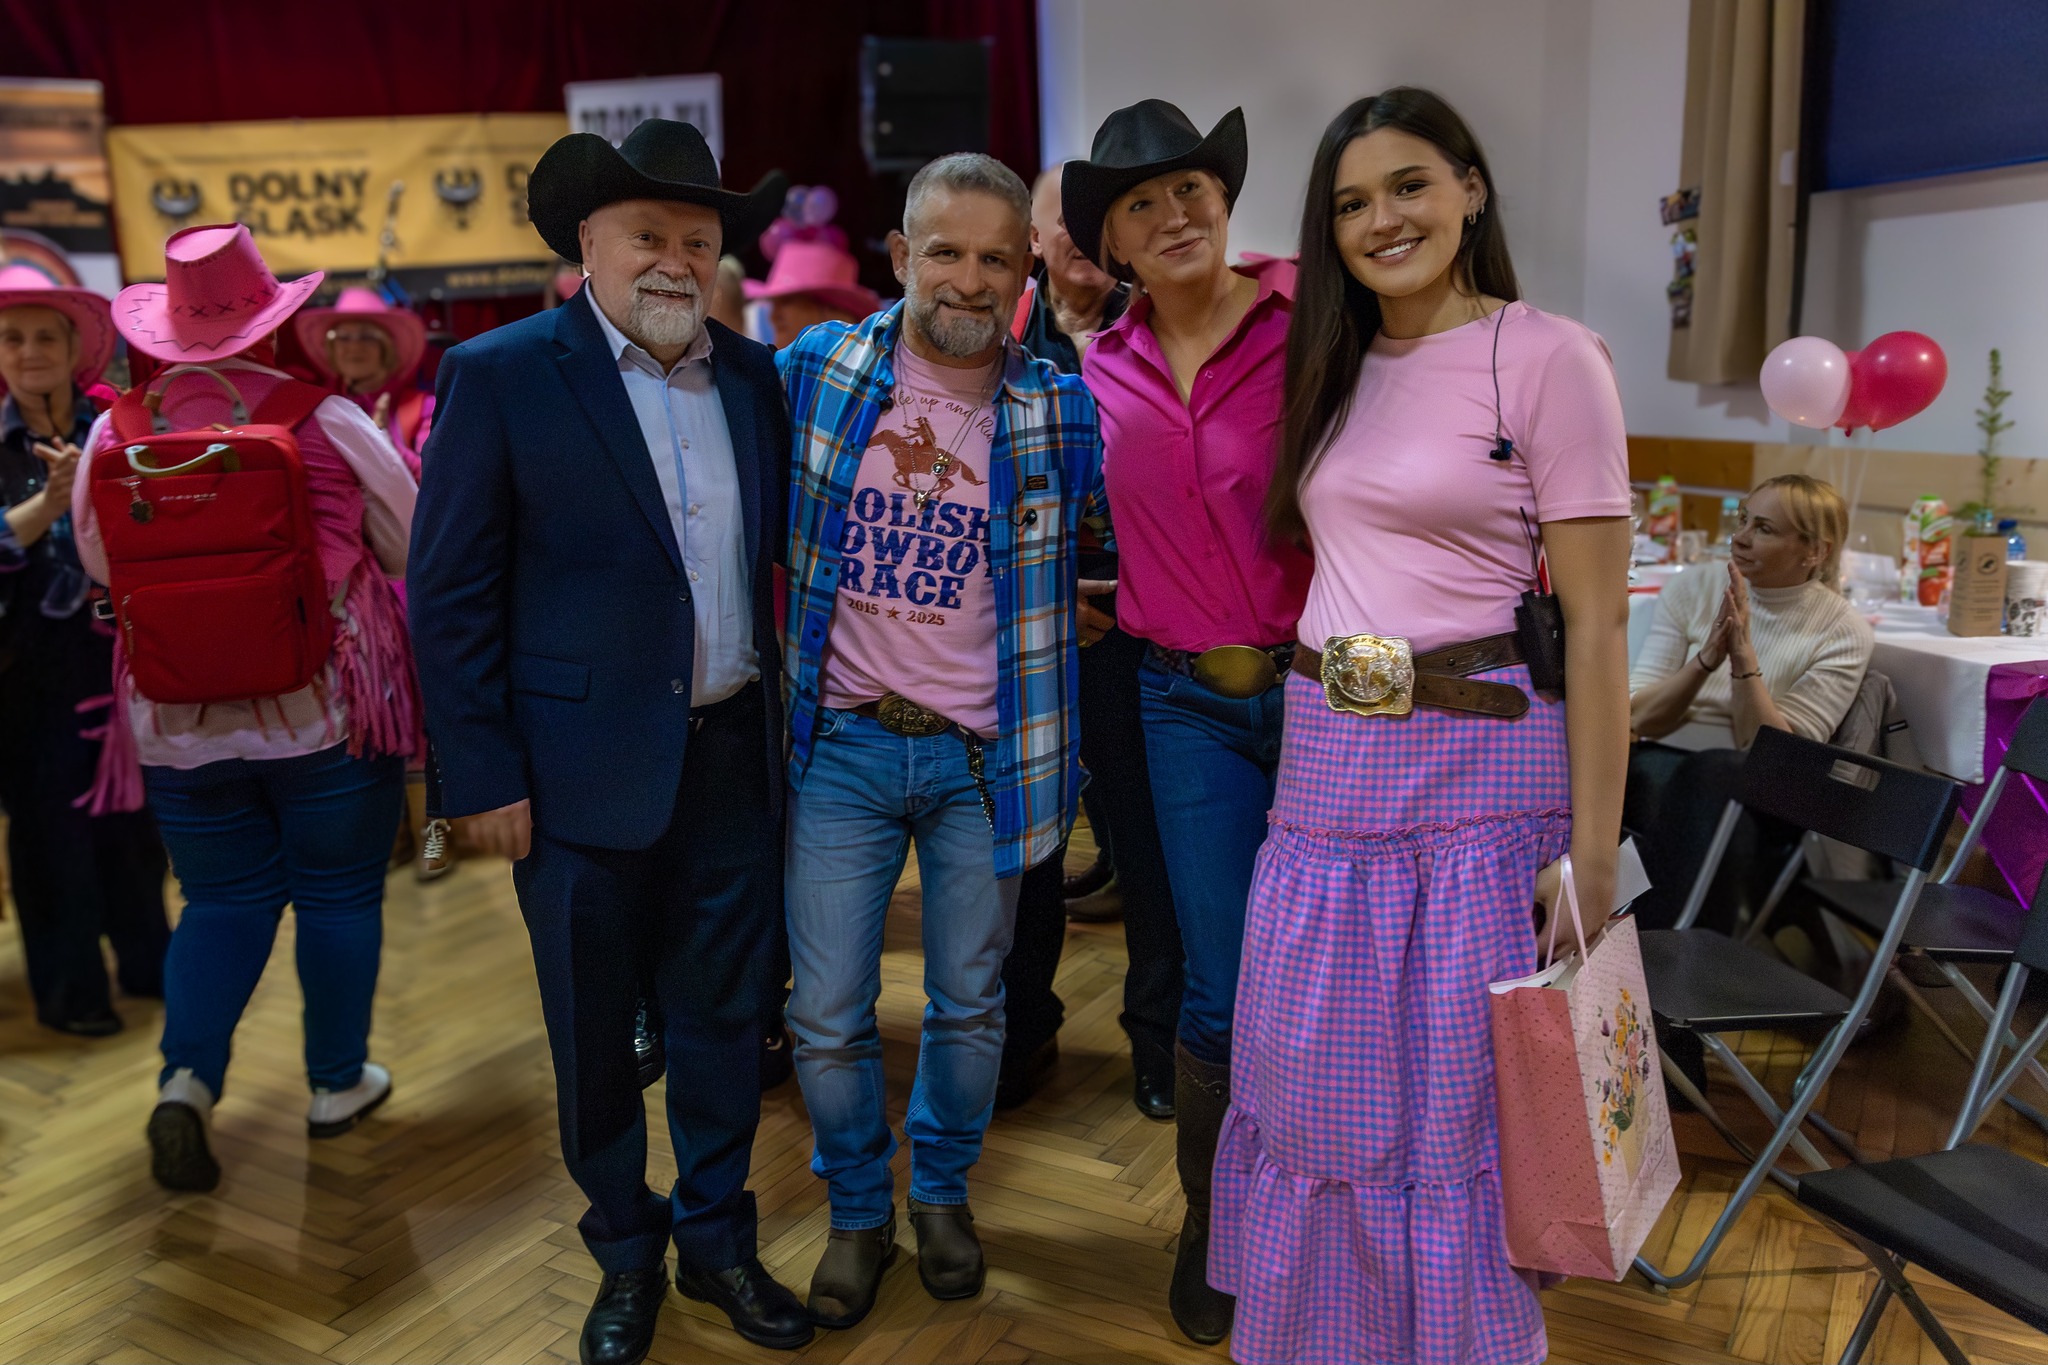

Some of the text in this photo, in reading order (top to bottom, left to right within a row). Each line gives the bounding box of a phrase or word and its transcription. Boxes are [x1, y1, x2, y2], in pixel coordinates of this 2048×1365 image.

[229, 169, 367, 204] DOLNY
[920, 397, 940, 412] up
[853, 487, 991, 543] OLISH
[840, 520, 993, 577] OWBO
[839, 555, 965, 610] RACE
[847, 599, 945, 626] 2015 2025
